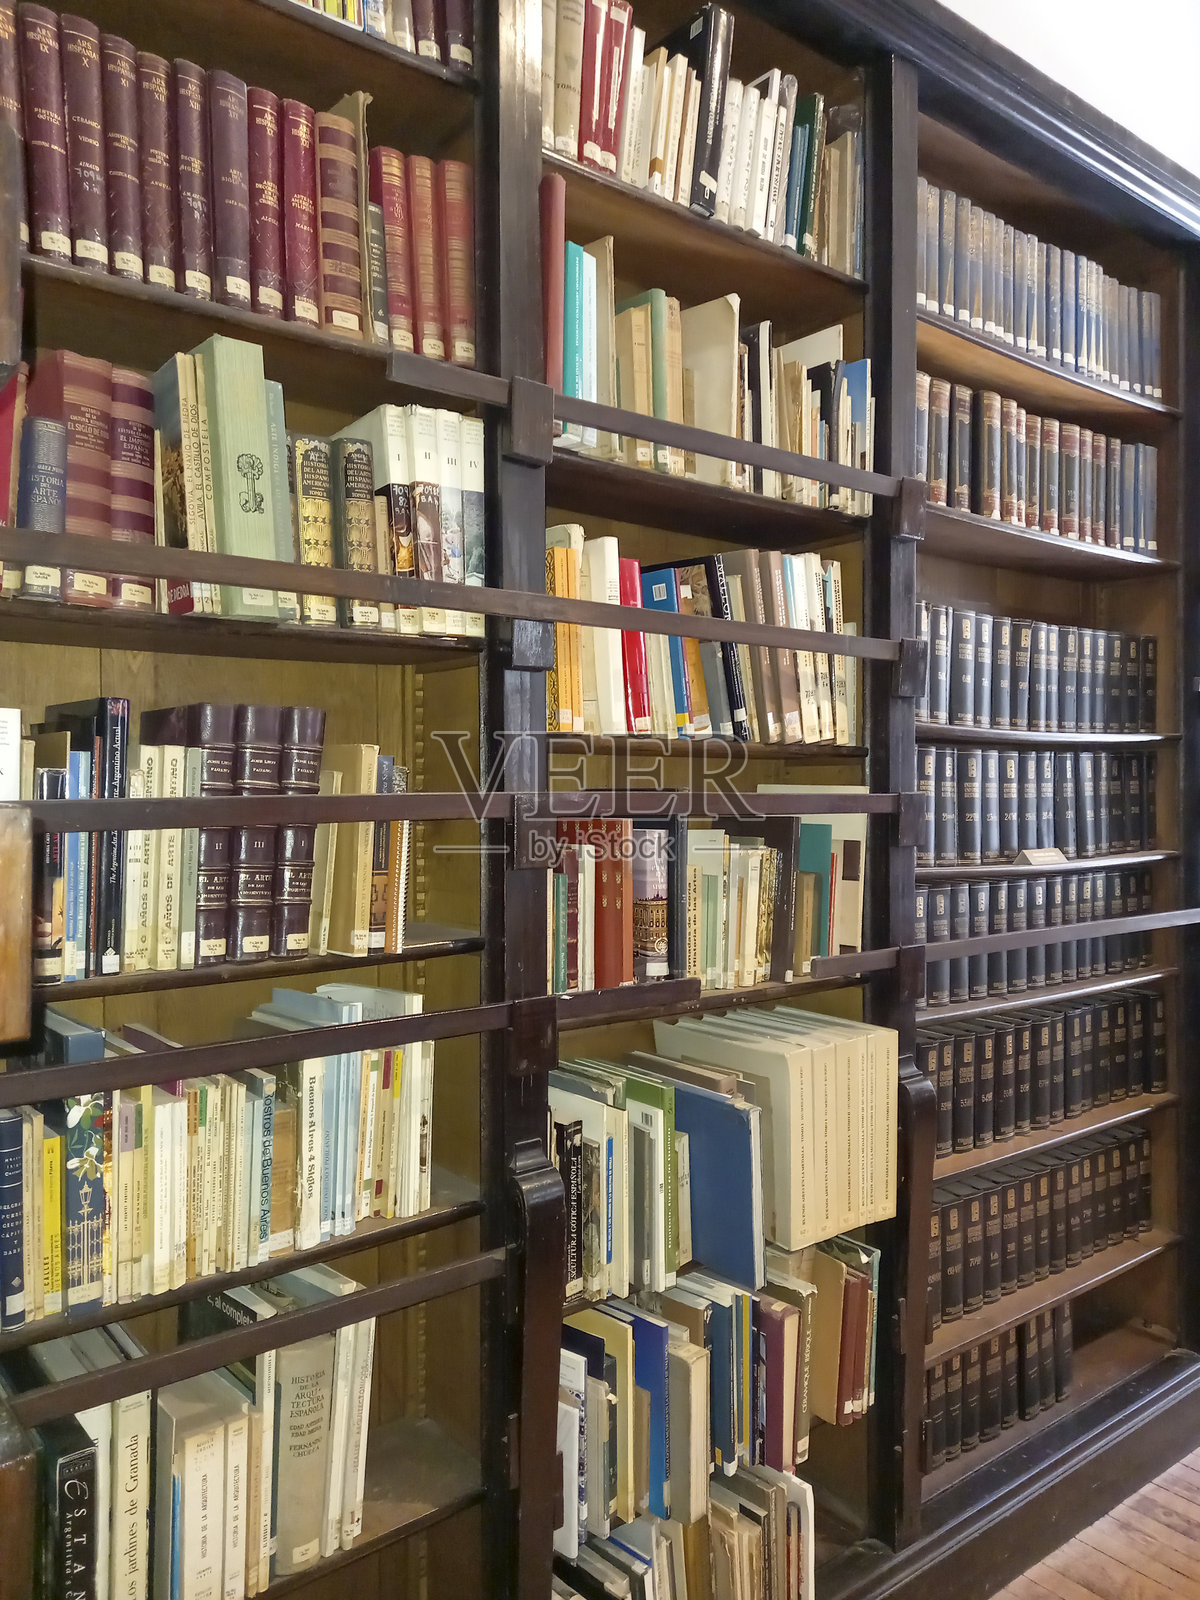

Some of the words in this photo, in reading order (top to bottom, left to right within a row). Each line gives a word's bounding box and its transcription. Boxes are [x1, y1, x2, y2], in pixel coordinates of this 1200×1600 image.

[36, 27, 50, 37] ARS
[40, 44, 49, 53] IX
[77, 39, 92, 50] ARS
[82, 57, 90, 68] X
[116, 59, 130, 70] ARS
[121, 78, 129, 87] XI
[152, 76, 166, 87] ARS
[78, 135, 99, 147] VIDRIO
[68, 422, 76, 430] EL
[76, 423, 92, 434] SIGLO
[184, 424, 190, 437] DE
[191, 427, 198, 438] DE
[193, 442, 201, 482] CASTILLO
[202, 418, 213, 500] COMPOSTELA
[397, 453, 401, 462] I
[424, 451, 431, 460] II
[447, 457, 457, 466] III
[470, 460, 480, 469] IV
[187, 473, 192, 484] EL
[33, 487, 58, 498] ARTE
[196, 484, 203, 496] EL
[188, 489, 196, 527] SEGOVIA
[204, 596, 210, 604] 2
[112, 727, 121, 751] Actual
[112, 752, 123, 787] Argentino
[143, 833, 151, 866] ARTE
[167, 835, 175, 867] ARTE
[215, 842, 223, 850] II
[110, 846, 119, 872] Argentine
[109, 872, 117, 884] The
[142, 871, 149, 888] DE
[165, 873, 173, 889] DE
[240, 873, 250, 881] EL
[139, 893, 150, 928] AÑOS
[163, 894, 173, 930] AÑOS
[687, 916, 692, 929] de
[692, 913, 697, 926] de
[308, 1075, 317, 1119] Buenos
[262, 1093, 275, 1137] Rostros
[308, 1119, 316, 1152] Aires
[262, 1140, 274, 1159] de
[308, 1154, 316, 1162] 4
[260, 1158, 273, 1207] Buenos
[306, 1163, 316, 1200] Siglos
[569, 1156, 578, 1200] ESPAÑOLA
[568, 1201, 578, 1232] GÓTICA
[259, 1209, 271, 1241] Aires
[570, 1233, 578, 1280] ESCULTURA
[214, 1295, 222, 1310] al
[290, 1369, 326, 1385] HISTORIA
[311, 1380, 319, 1388] LA
[290, 1394, 325, 1409] TECTURA
[289, 1402, 324, 1418] ESPAÑOLA
[124, 1434, 139, 1493] Granada
[232, 1463, 240, 1501] ARQUITECTURA
[200, 1473, 209, 1511] ARQUITECTURA
[124, 1500, 138, 1516] de
[200, 1514, 208, 1522] LA
[200, 1523, 208, 1532] DE
[123, 1521, 139, 1577] jardines
